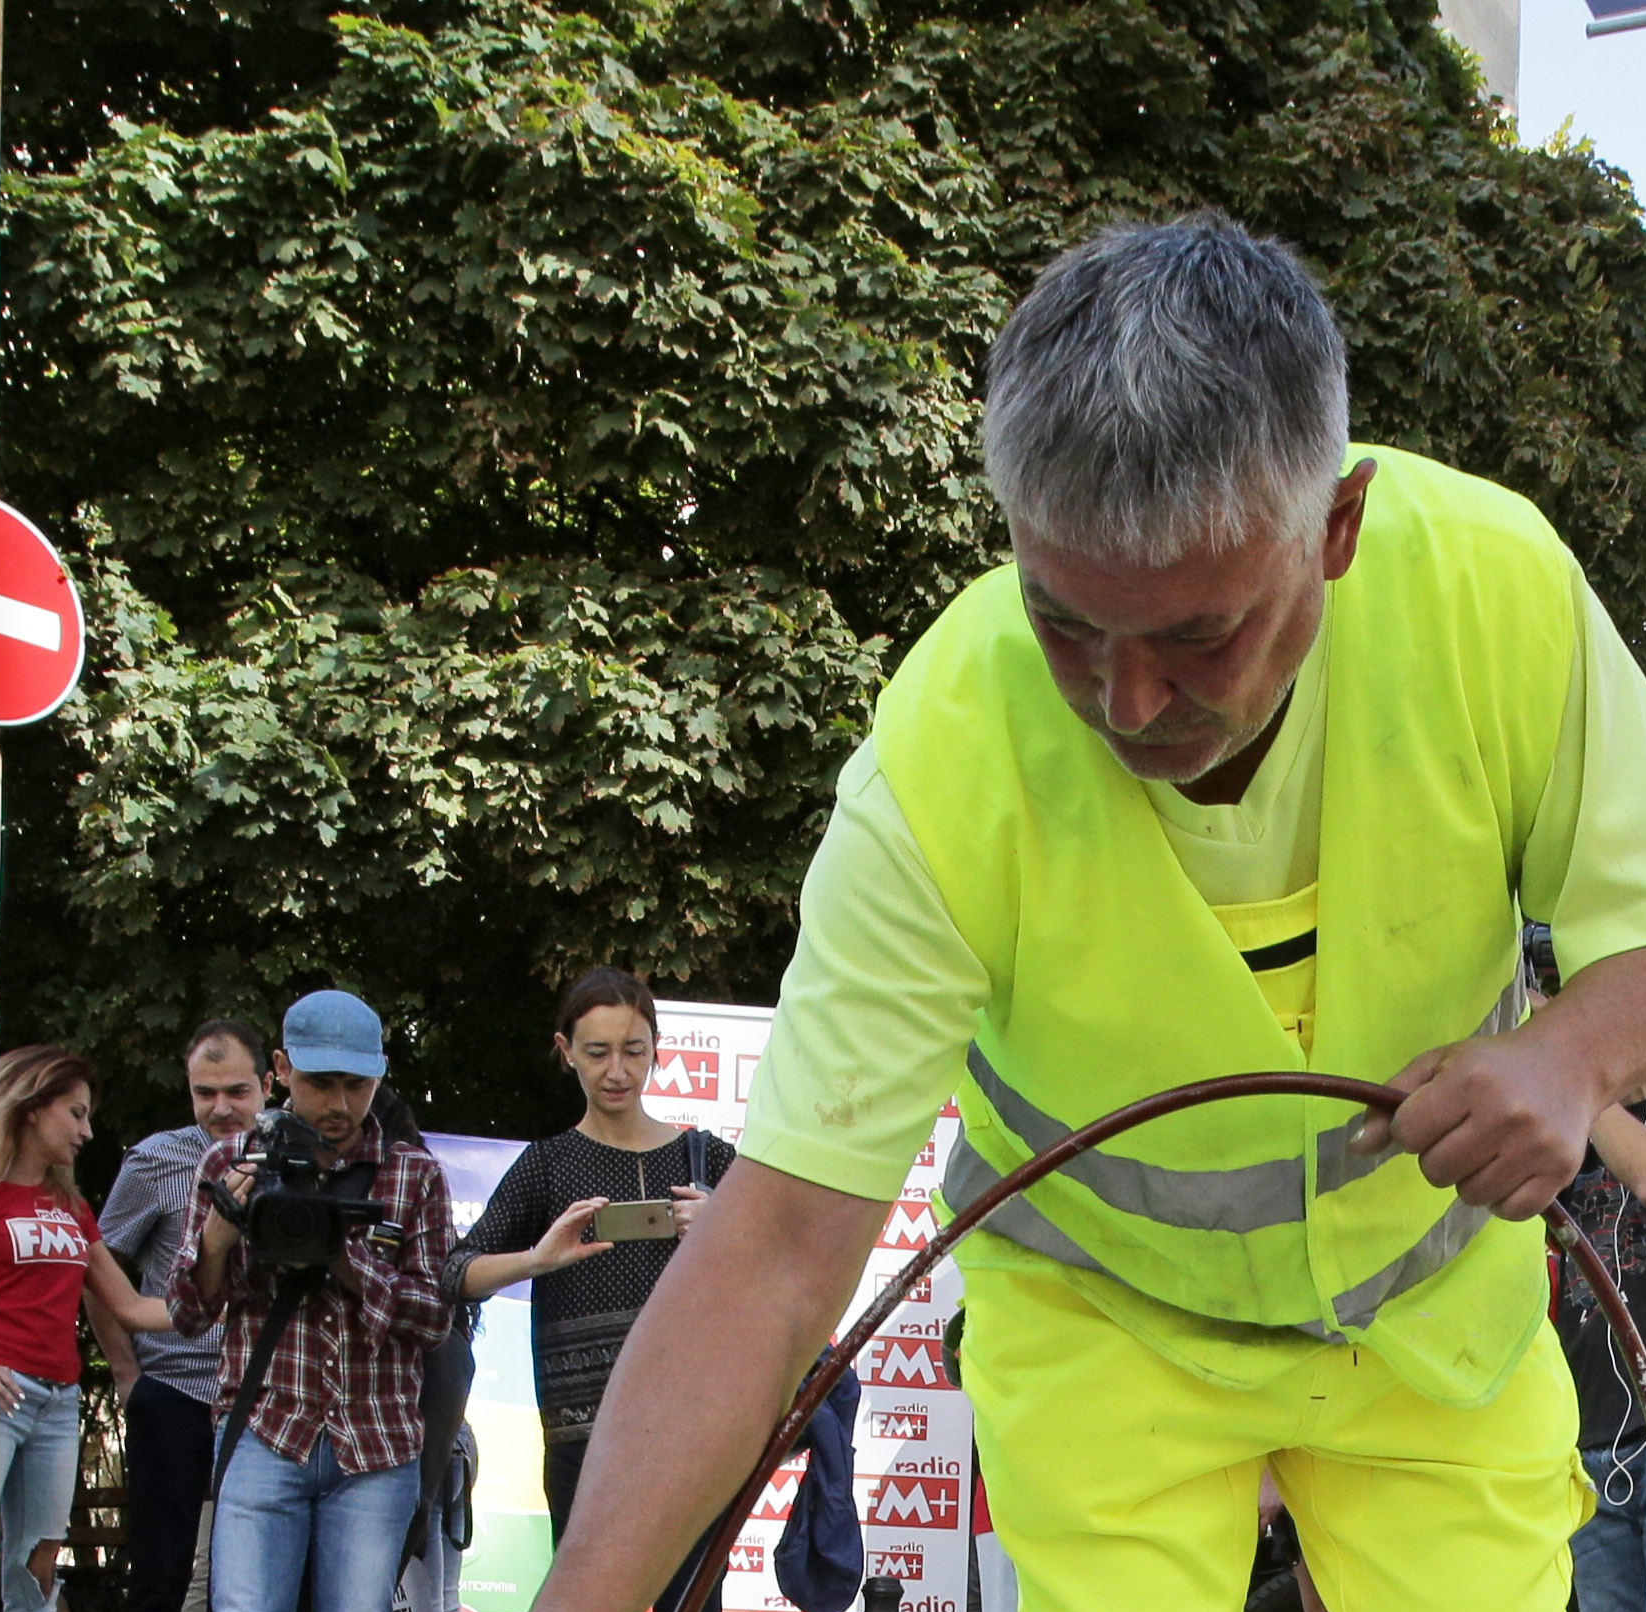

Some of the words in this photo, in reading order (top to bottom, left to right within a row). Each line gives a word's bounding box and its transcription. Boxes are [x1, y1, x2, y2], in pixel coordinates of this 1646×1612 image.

[9, 1221, 89, 1258] FM+
[894, 1403, 928, 1414] radio
[872, 1414, 927, 1438] FM+
[895, 1456, 960, 1476] radio
[853, 1478, 957, 1524] FM+
[734, 1534, 765, 1545] adio
[889, 1542, 924, 1553] radio
[728, 1548, 764, 1571] M+
[868, 1553, 923, 1578] FM+
